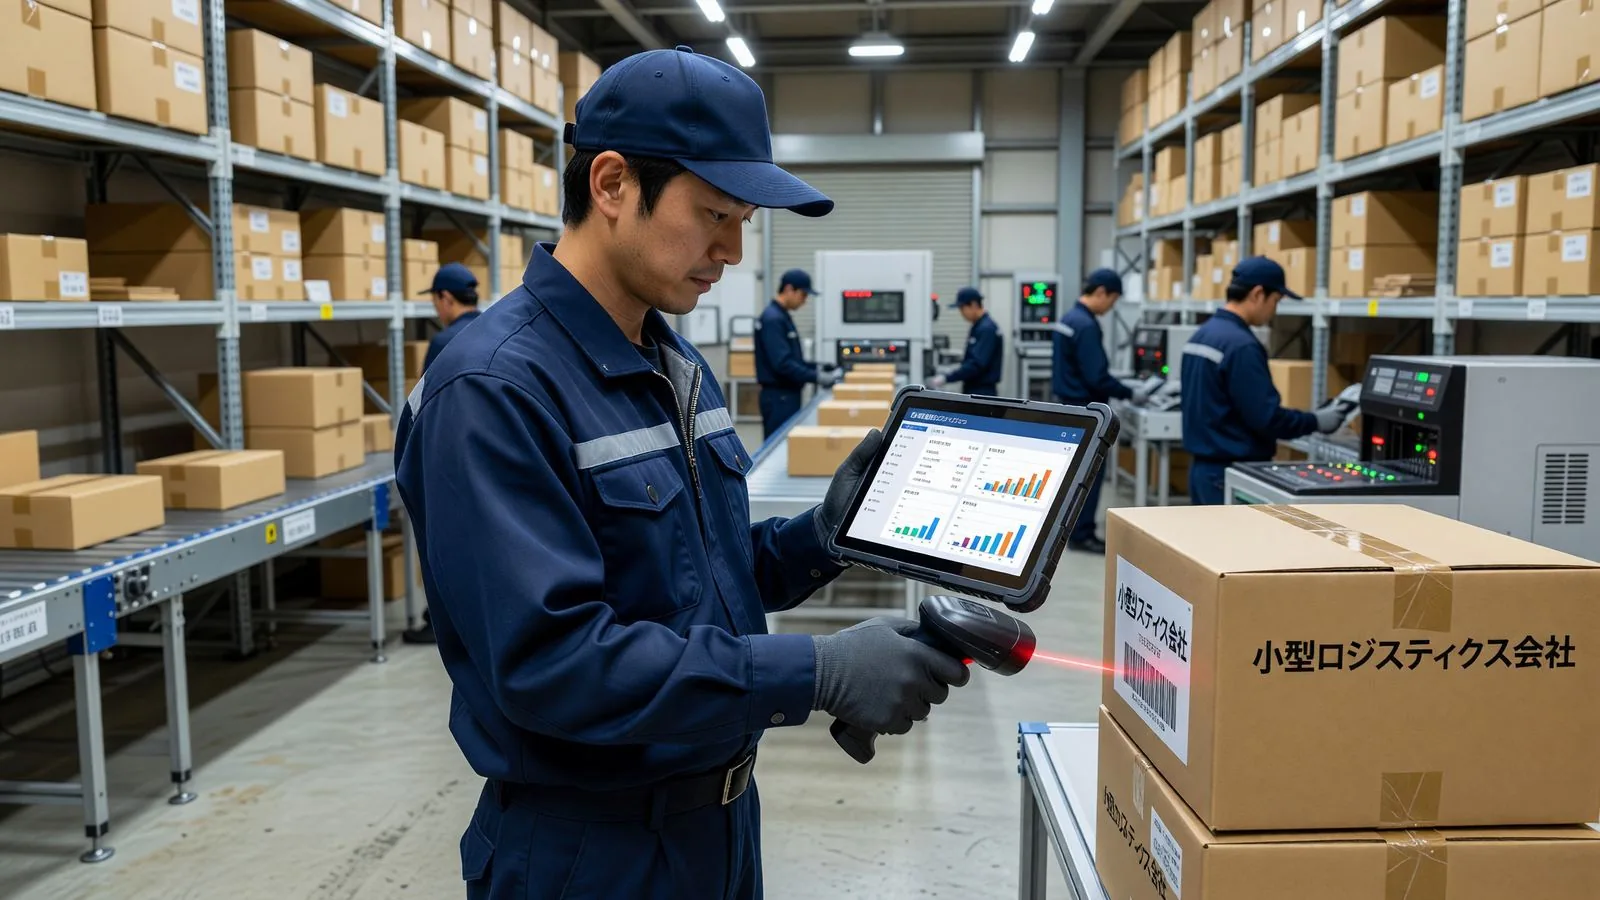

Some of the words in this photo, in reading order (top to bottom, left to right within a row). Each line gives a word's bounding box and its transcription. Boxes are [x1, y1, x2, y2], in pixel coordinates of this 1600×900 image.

[1253, 635, 1576, 675] 小型ロジスティクス会社
